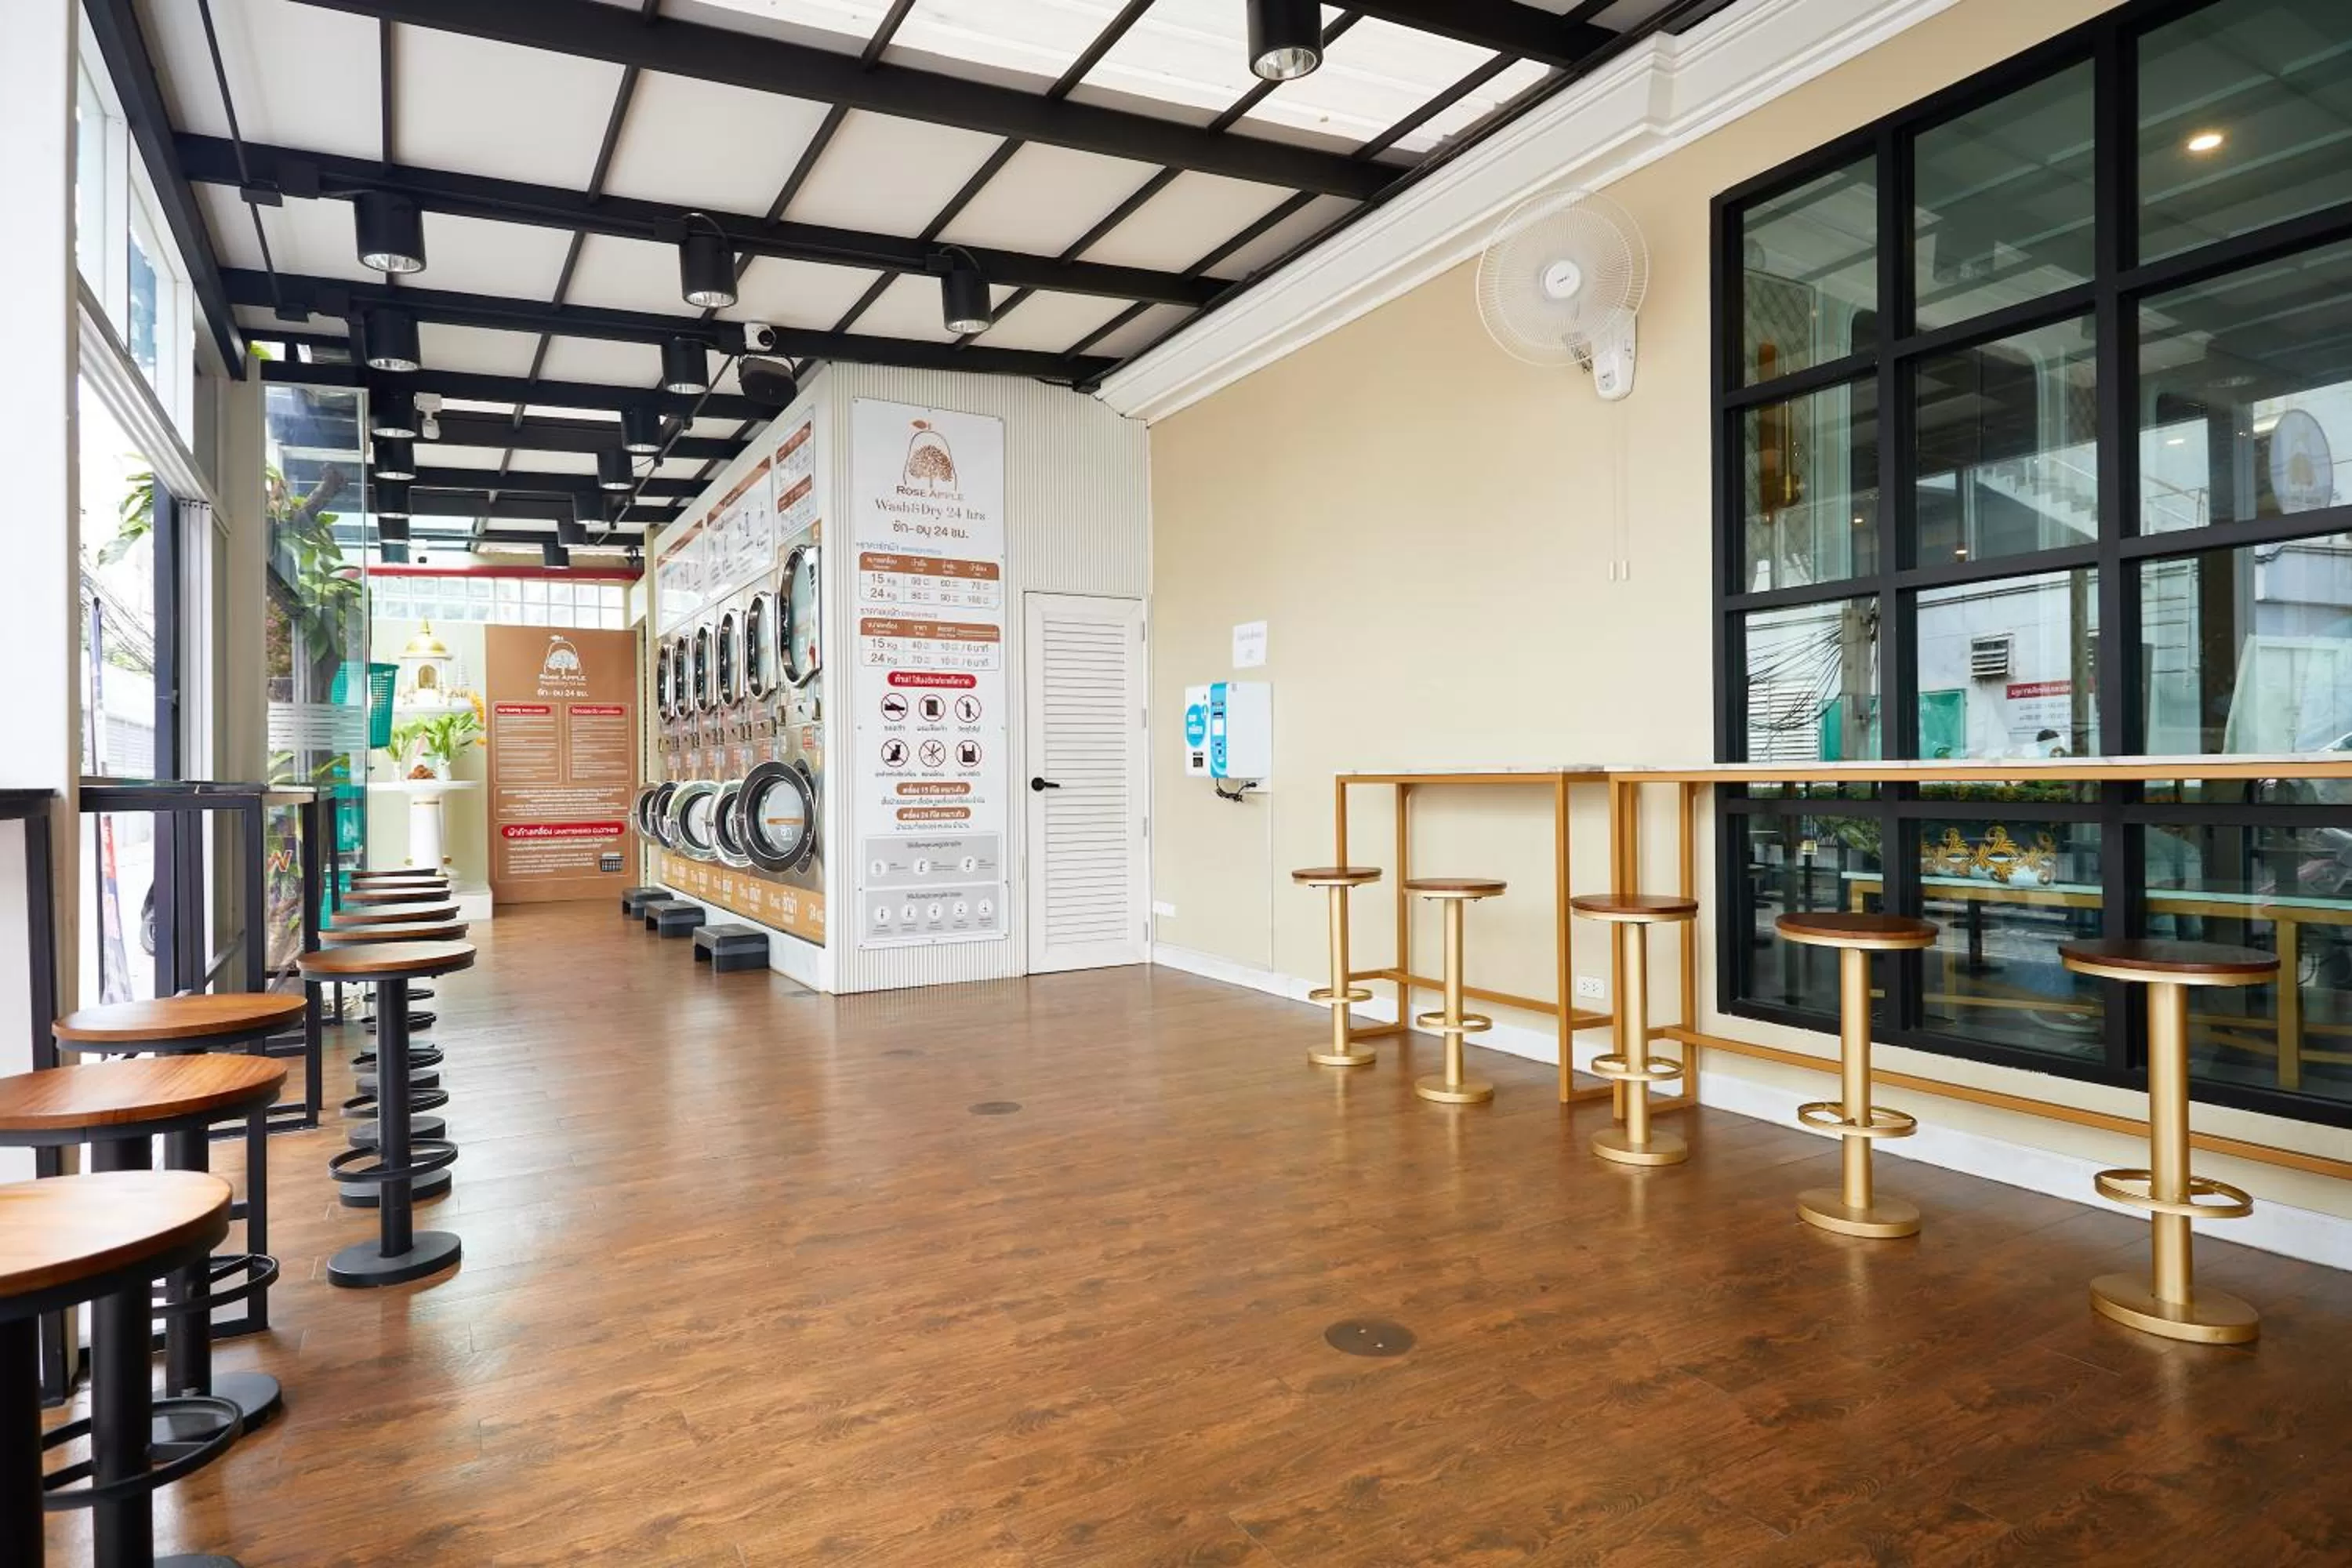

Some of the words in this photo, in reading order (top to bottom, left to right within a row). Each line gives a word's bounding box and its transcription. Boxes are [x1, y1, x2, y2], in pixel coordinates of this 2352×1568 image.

[896, 485, 926, 497] ROSE
[929, 488, 965, 501] APPLE
[946, 506, 962, 519] 24
[934, 526, 949, 537] 24
[871, 573, 885, 585] 15
[869, 588, 884, 599] 24
[871, 637, 885, 648] 15
[870, 652, 885, 663] 24
